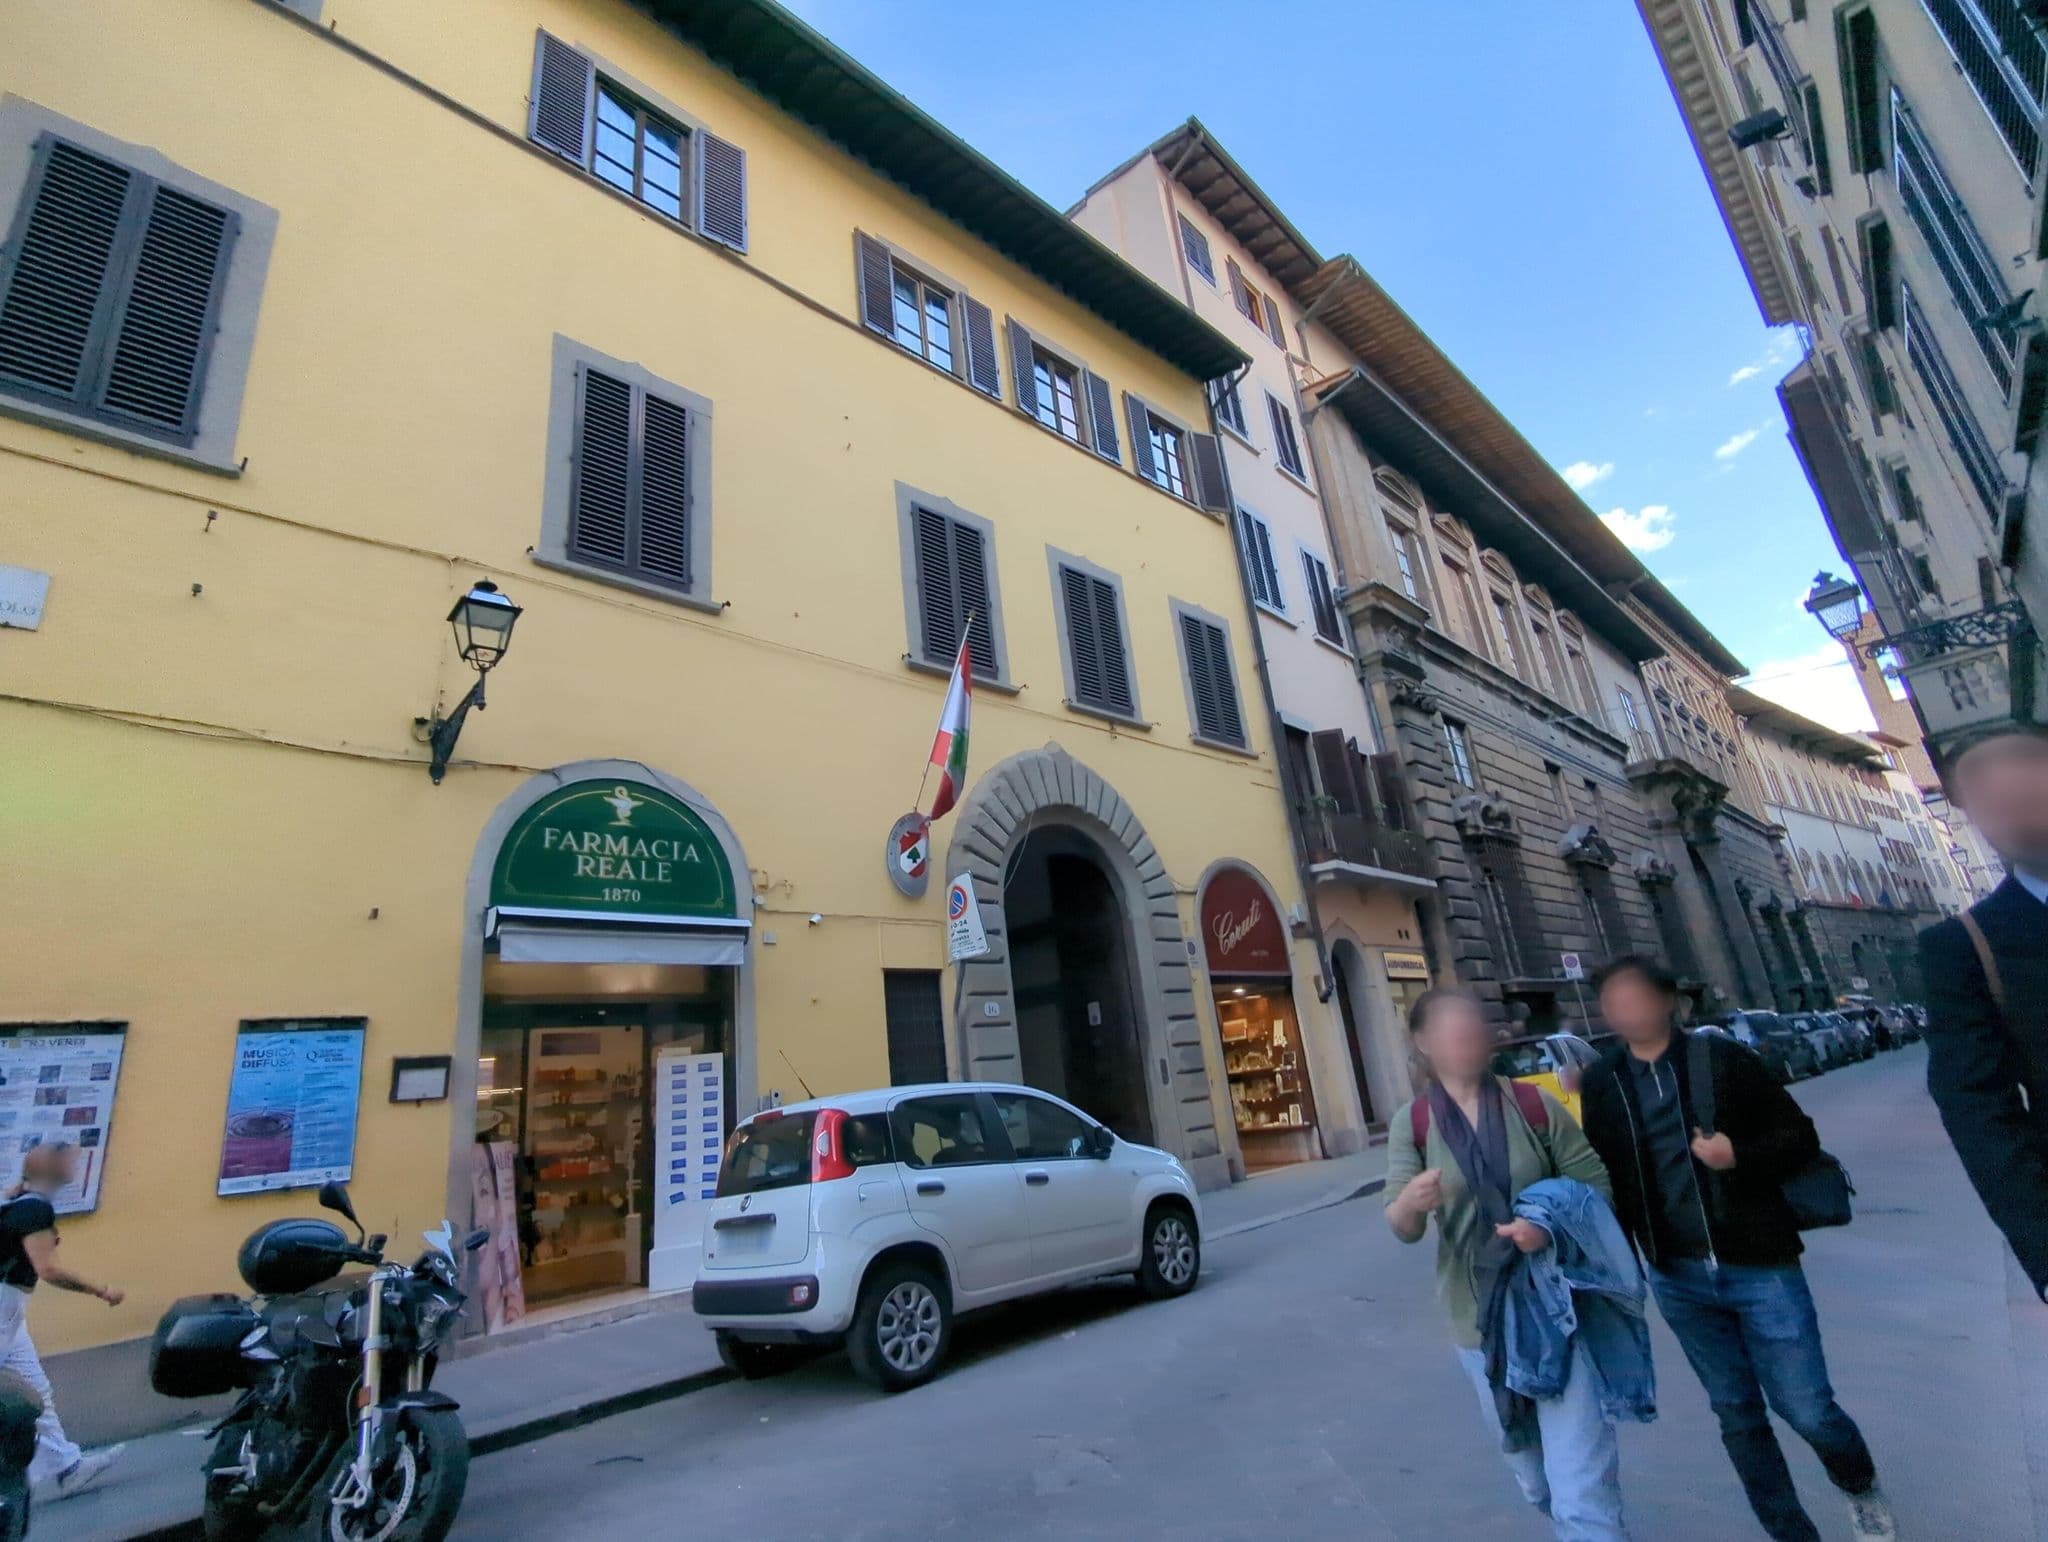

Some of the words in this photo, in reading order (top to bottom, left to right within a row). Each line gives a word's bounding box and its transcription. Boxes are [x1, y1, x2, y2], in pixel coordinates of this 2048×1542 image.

[542, 827, 702, 864] FARMACIA
[573, 854, 673, 884] REALE
[601, 887, 641, 903] 1870
[49, 1037, 86, 1047] VERDI
[243, 1047, 297, 1060] MUSICA
